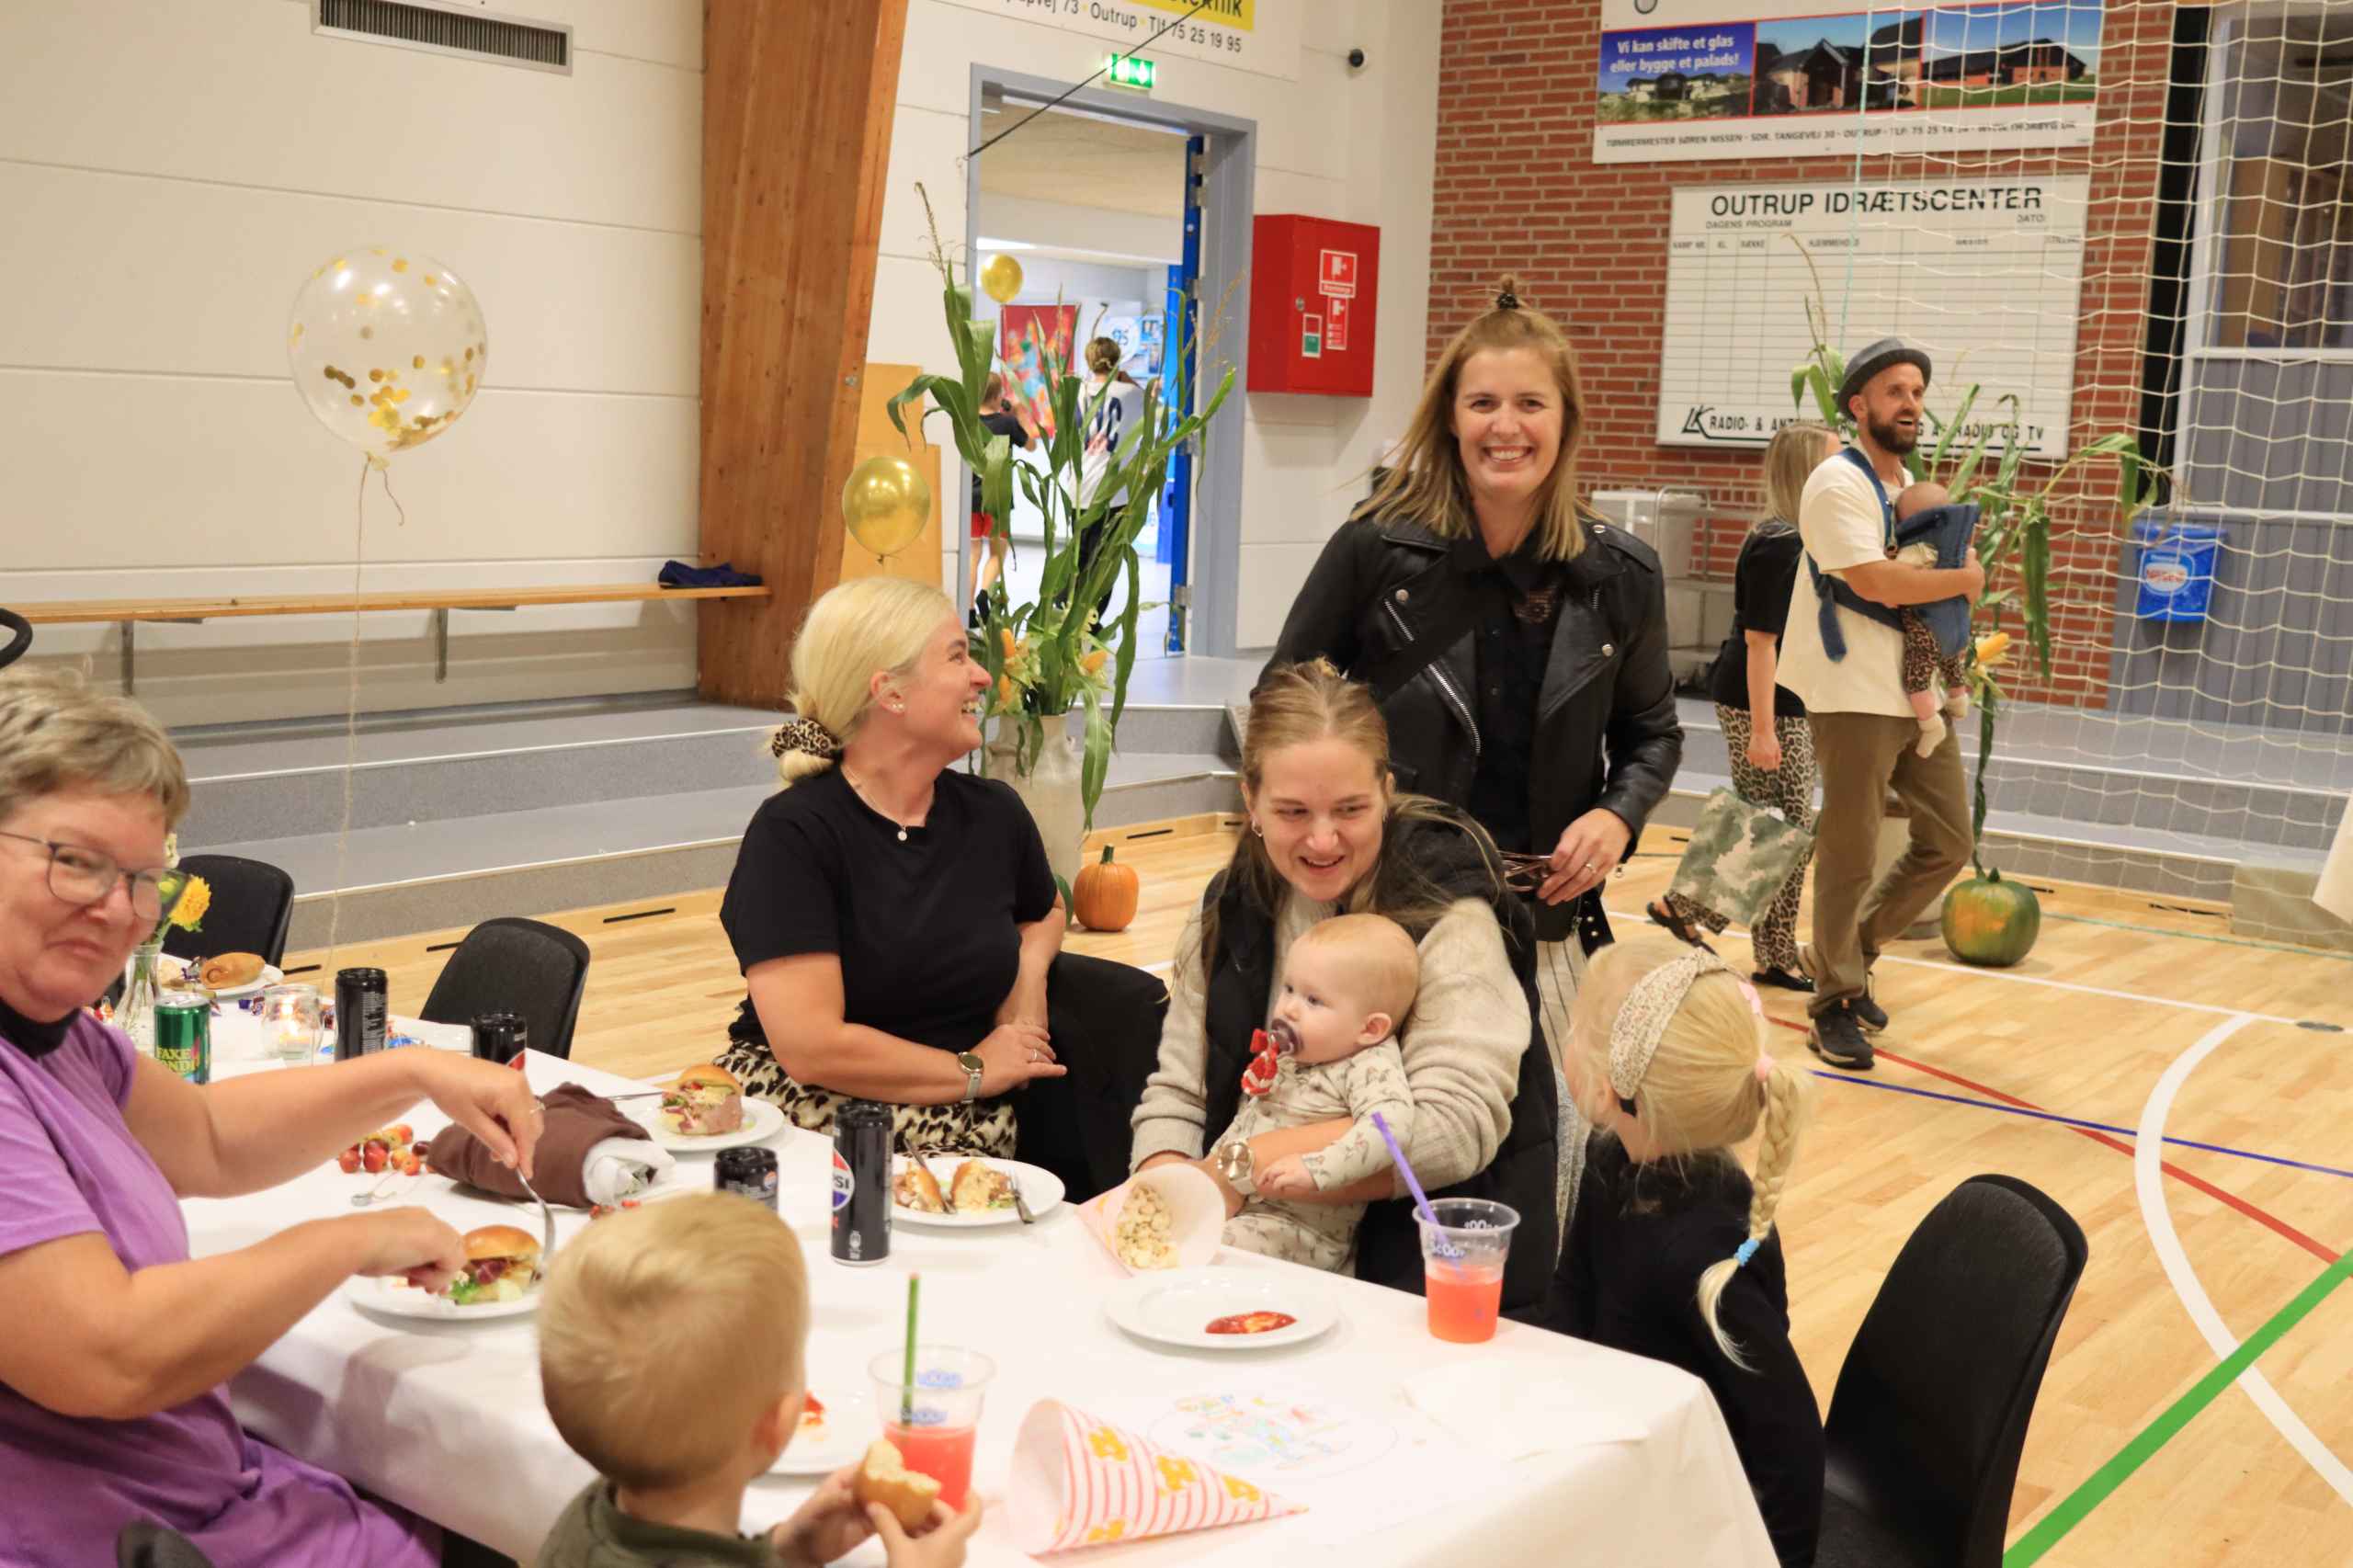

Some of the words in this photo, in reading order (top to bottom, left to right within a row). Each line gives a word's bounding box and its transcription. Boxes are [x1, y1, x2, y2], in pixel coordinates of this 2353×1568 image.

[1090, 2, 1137, 31] Outrup
[1170, 21, 1185, 40] 75
[1190, 27, 1205, 44] 25
[1211, 31, 1222, 49] 19
[1227, 35, 1242, 52] 95
[1617, 40, 1630, 53] Vi
[1632, 39, 1654, 52] kan
[1656, 37, 1689, 51] skifte
[1692, 37, 1706, 49] et
[1709, 34, 1734, 50] glas
[1610, 60, 1637, 73] eller
[1640, 58, 1676, 74] bygge
[1679, 57, 1692, 68] et
[1694, 53, 1739, 71] palads!
[1843, 127, 1881, 139] OURUP
[1711, 193, 1813, 216] OUTRUP
[1824, 187, 2041, 213] IDRÆTSCENTER
[1706, 221, 1743, 230] DAGENS
[1746, 219, 1792, 229] PROGRAM
[1756, 417, 1762, 431] &
[2028, 426, 2044, 440] TV
